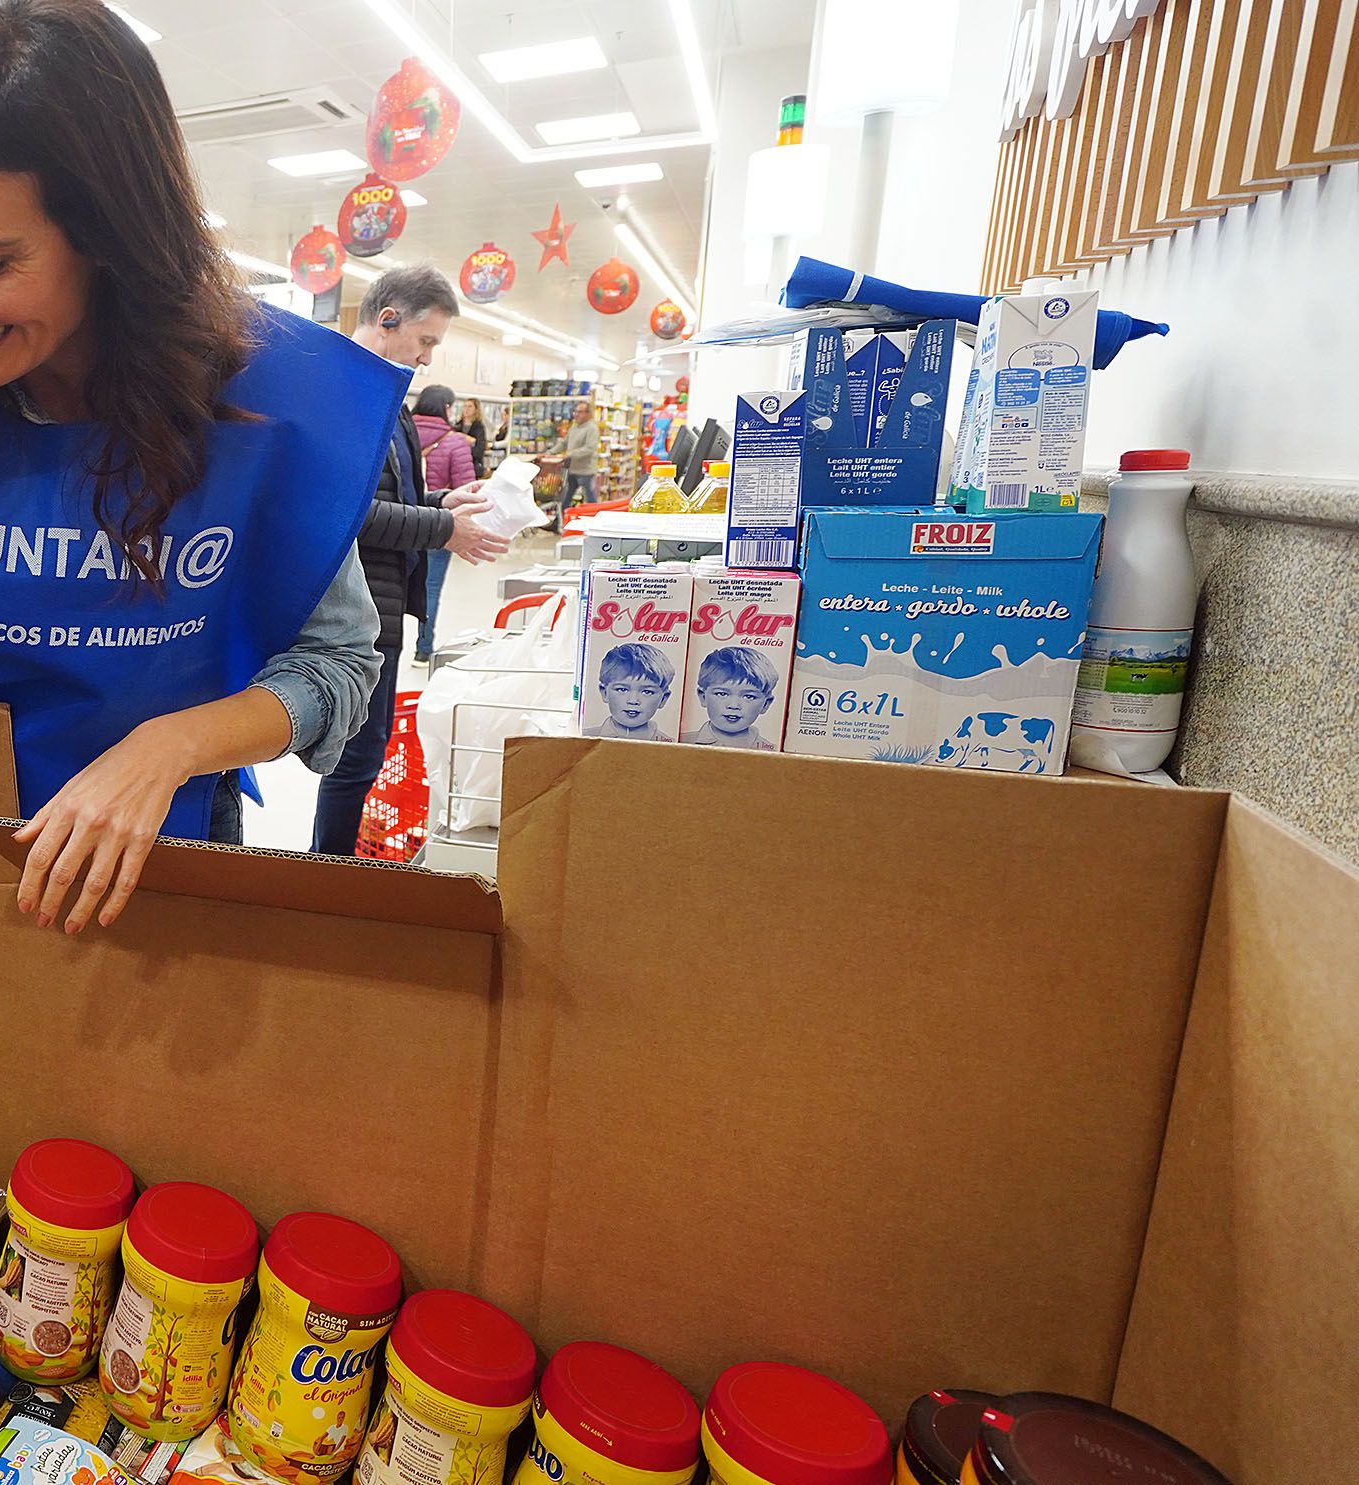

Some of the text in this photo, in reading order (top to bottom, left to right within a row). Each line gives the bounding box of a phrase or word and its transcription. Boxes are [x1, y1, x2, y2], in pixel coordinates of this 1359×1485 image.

[353, 188, 394, 206] 1000
[472, 254, 507, 266] 1000
[840, 487, 847, 495] 6
[914, 524, 994, 544] FROIZ
[882, 583, 918, 593] Leche
[932, 584, 963, 595] Leite
[976, 586, 1003, 596] Milk
[819, 594, 1070, 620] entera gordo whole
[592, 601, 689, 638] Solar
[691, 603, 794, 640] Solar
[49, 627, 80, 648] DE
[86, 616, 206, 648] ALIMENTOS
[650, 634, 680, 643] Galicia
[740, 637, 784, 647] de Galicia
[307, 1315, 346, 1332] NATURAL
[319, 1312, 348, 1326] CACAO
[303, 1386, 320, 1401] el
[7, 1442, 34, 1469] baby
[31, 1446, 55, 1473] frutas
[47, 1444, 75, 1484] variadas
[302, 1463, 333, 1471] CACAO
